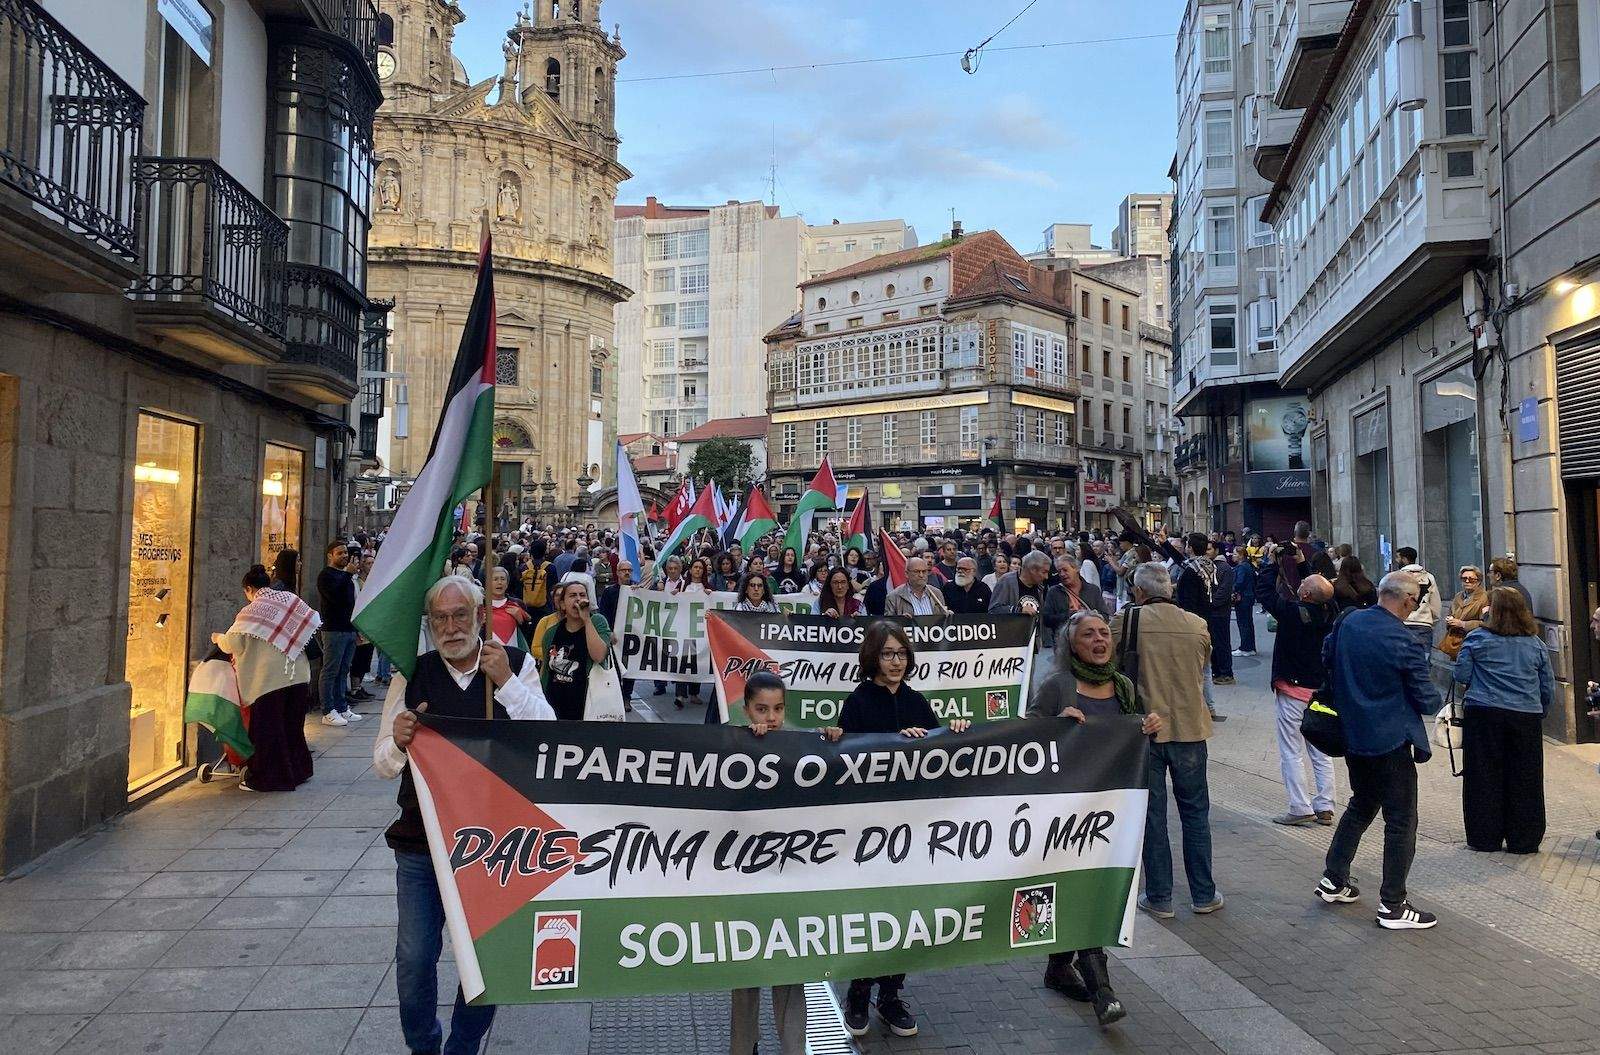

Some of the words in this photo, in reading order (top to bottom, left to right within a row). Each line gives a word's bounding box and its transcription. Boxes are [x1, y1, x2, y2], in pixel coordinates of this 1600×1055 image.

[139, 533, 153, 546] MES
[624, 596, 679, 638] PAZ
[760, 623, 865, 644] ¡PAREMOS
[903, 623, 997, 643] ENOCIDIO!
[620, 634, 699, 675] PARA
[937, 661, 967, 681] RIO
[974, 653, 984, 678] Ó
[989, 657, 1025, 680] MAR
[534, 742, 780, 790] ¡PAREMOS
[793, 754, 828, 788] O
[835, 741, 1061, 785] XENOCIDIO!
[449, 822, 709, 889] PALESTINA
[713, 828, 846, 874] LIBRE
[854, 823, 912, 867] DO
[928, 819, 992, 866] RIO
[1009, 802, 1032, 858] Ó
[1043, 810, 1115, 861] MAR
[618, 905, 986, 969] SOLIDARIEDADE
[1014, 894, 1030, 939] PONTEVEDRA
[537, 966, 574, 984] CGT
